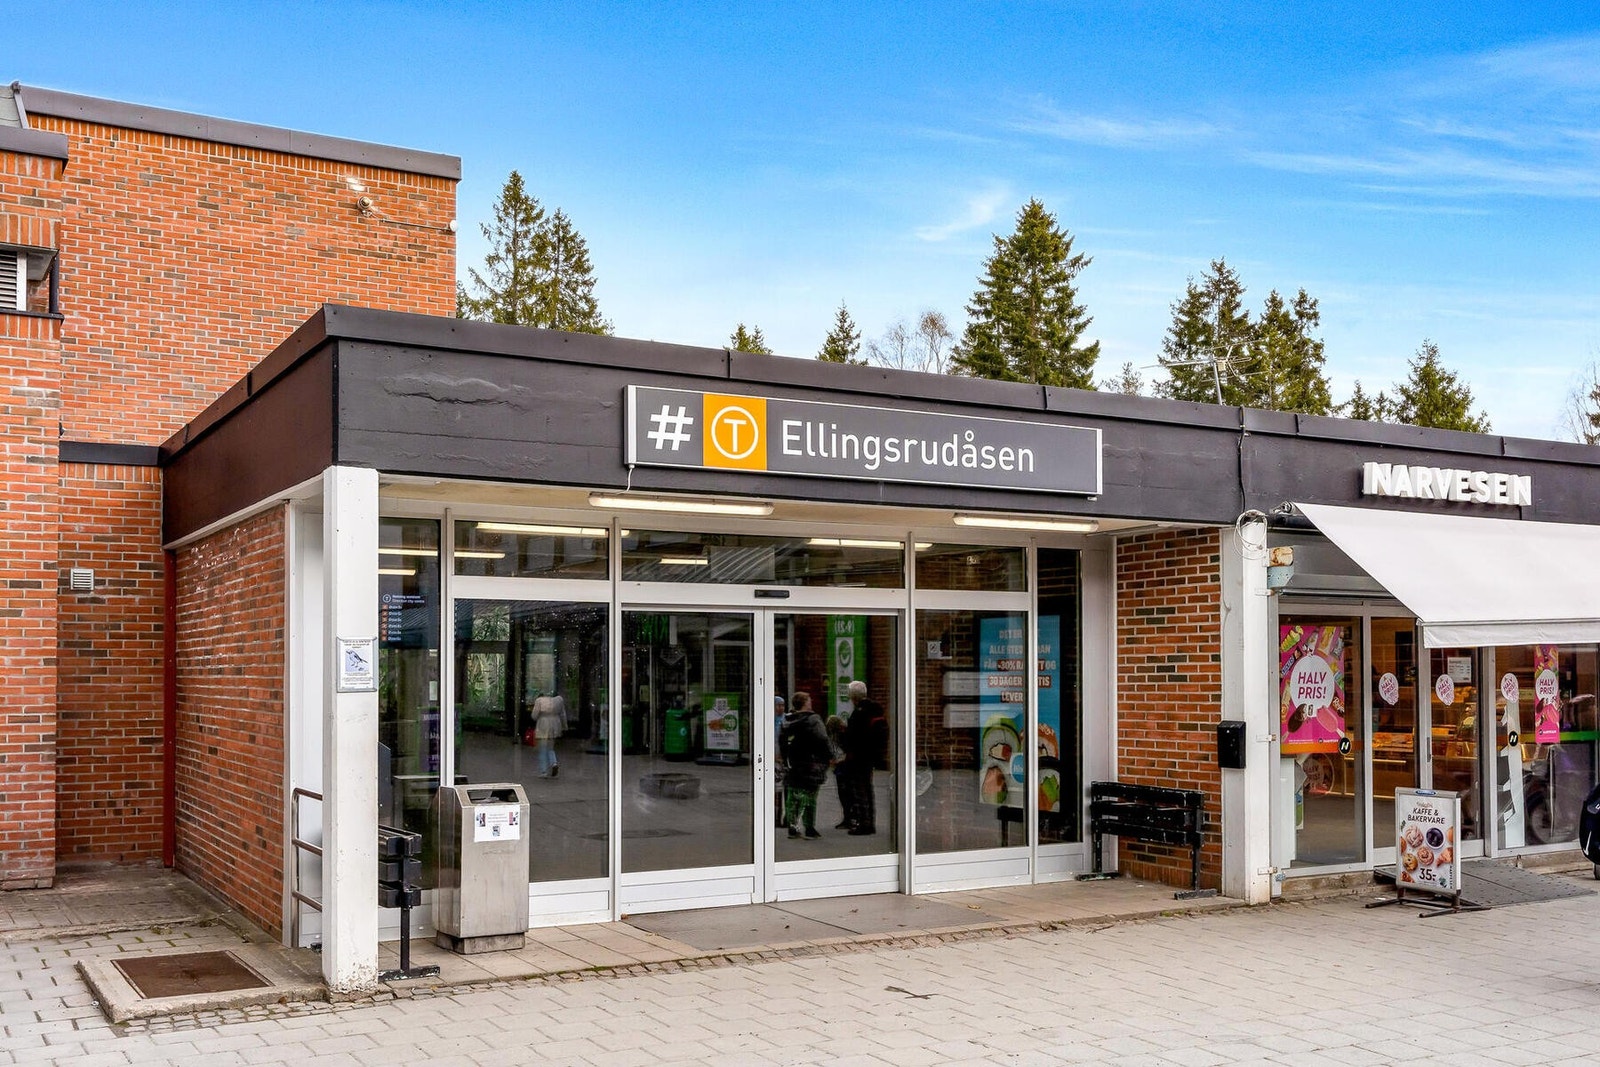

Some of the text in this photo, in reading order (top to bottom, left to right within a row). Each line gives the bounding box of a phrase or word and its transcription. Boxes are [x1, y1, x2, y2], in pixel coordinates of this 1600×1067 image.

[782, 419, 1035, 473] Ellingsrudåsen
[1363, 461, 1532, 506] NARVESEN
[1298, 672, 1327, 684] HALV
[1539, 678, 1554, 687] HALV
[1298, 687, 1327, 699] PRIS!
[1539, 687, 1554, 695] PRIS!
[1413, 808, 1432, 816] KAFFE
[1408, 815, 1445, 824] BAKERVARE
